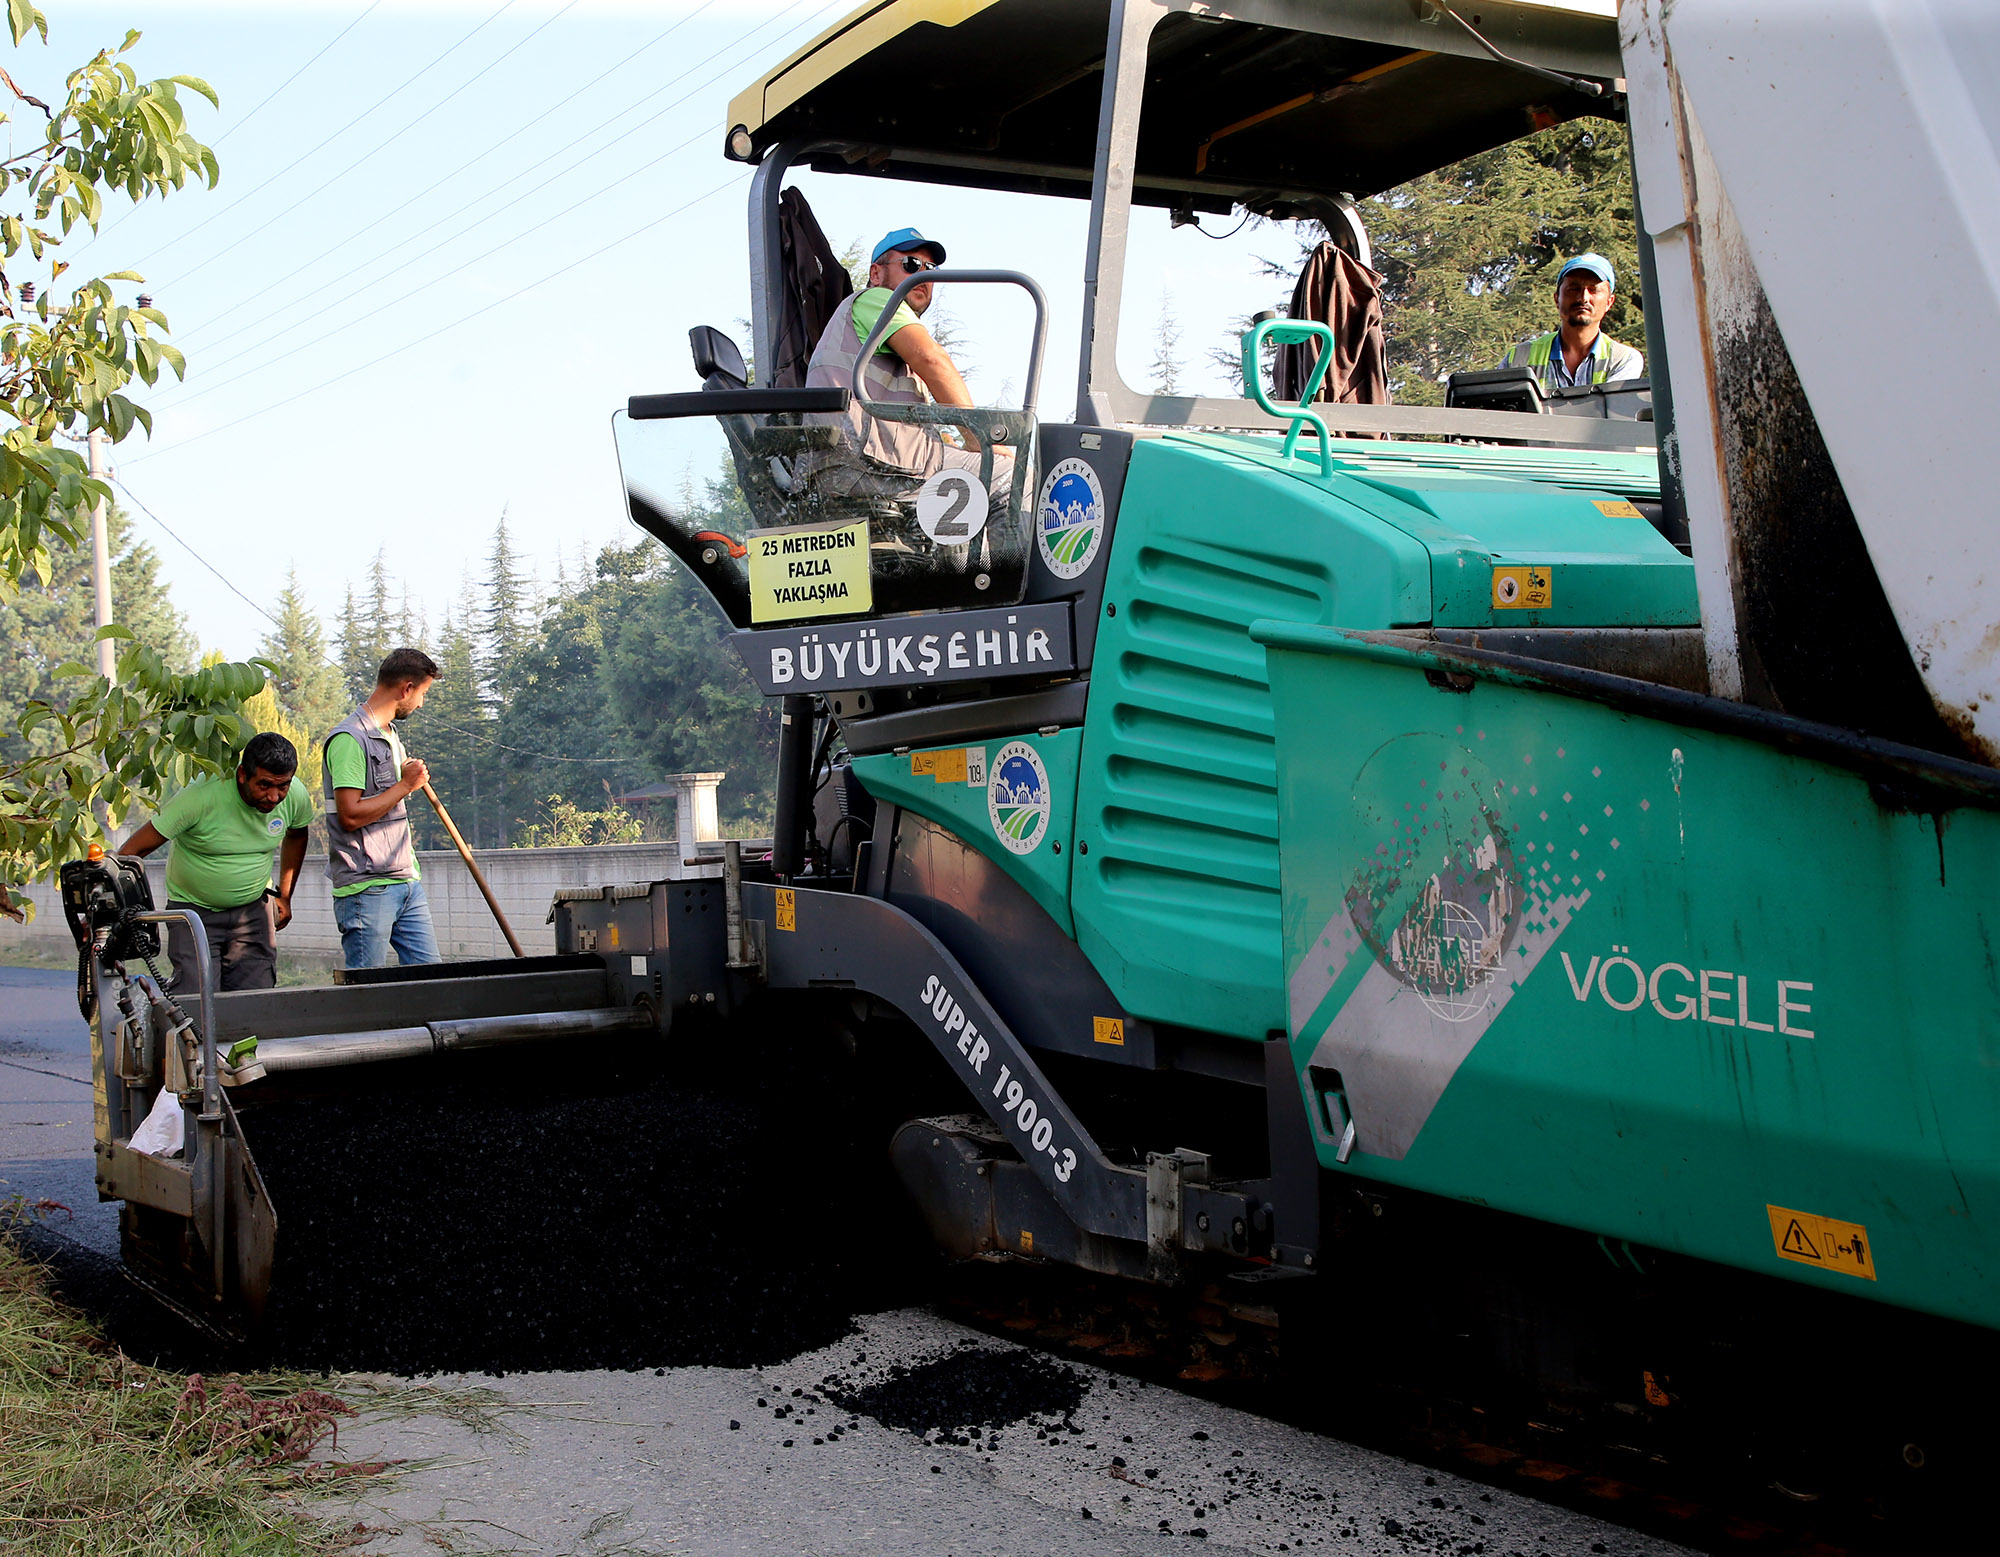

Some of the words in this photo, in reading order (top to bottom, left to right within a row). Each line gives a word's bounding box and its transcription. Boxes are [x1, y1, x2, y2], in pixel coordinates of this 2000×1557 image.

[1046, 463, 1091, 491] SAKARYA
[933, 477, 971, 537] 2
[761, 538, 779, 556] 25
[782, 531, 856, 554] METREDEN
[788, 559, 832, 578] FAZLA
[773, 581, 849, 604] YAKLAŞMA
[770, 615, 1053, 684] BÜYÜKŞEHİR
[997, 747, 1038, 768] SAKARYA
[968, 764, 982, 783] 109
[1560, 944, 1815, 1039] VÖGELE
[920, 974, 990, 1076] SUPER
[992, 1063, 1077, 1183] 1900-3
